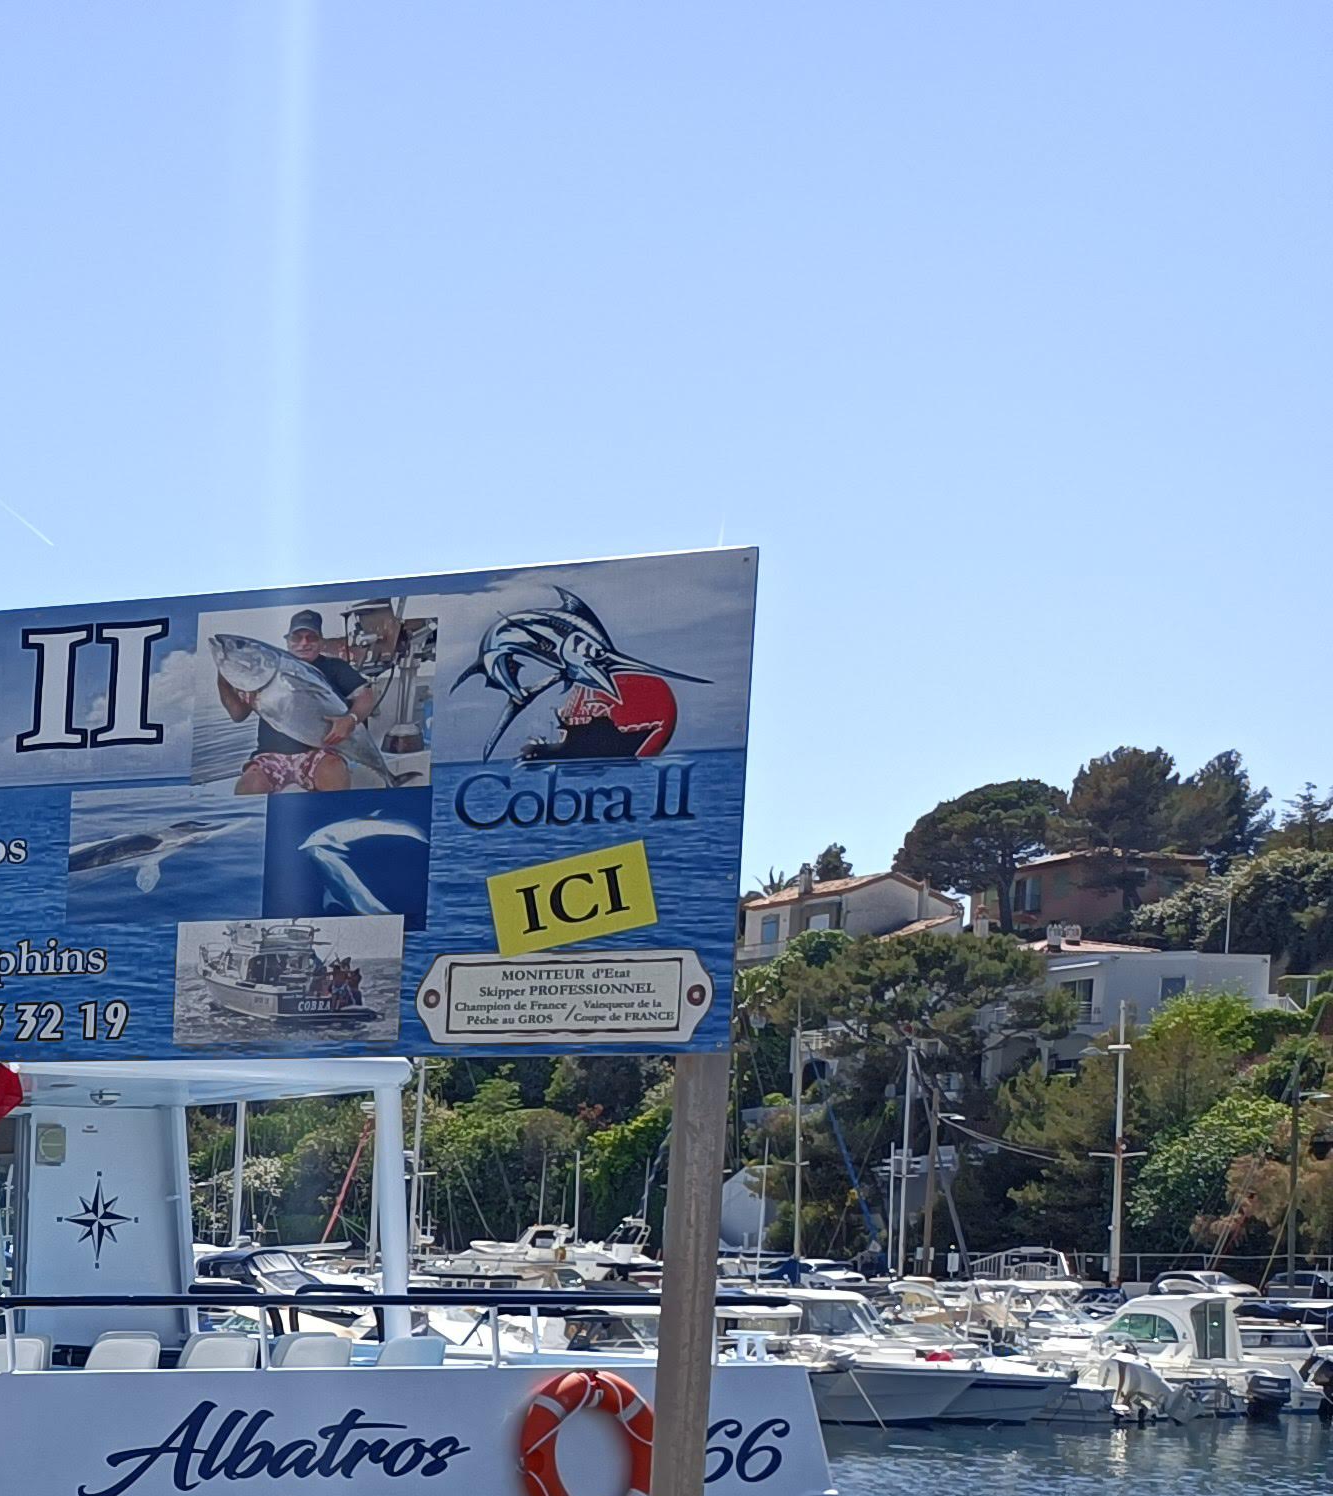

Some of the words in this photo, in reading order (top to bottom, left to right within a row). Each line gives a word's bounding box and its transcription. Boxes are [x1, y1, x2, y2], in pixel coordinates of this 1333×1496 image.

[16, 618, 169, 754] II
[453, 765, 631, 830] Cobra
[649, 759, 696, 822] II
[515, 862, 630, 935] ICI
[501, 969, 585, 981] MONITEUR
[592, 968, 630, 979] d'Etat
[480, 986, 525, 999] Skipper
[529, 983, 656, 996] PROFESSIONNEL
[297, 1001, 331, 1012] COBRA
[454, 1001, 512, 1015] Champion
[514, 1001, 527, 1011] de
[530, 1001, 568, 1011] France
[637, 999, 651, 1008] de
[15, 1002, 63, 1040] 32
[80, 1000, 129, 1039] 19
[466, 1014, 499, 1025] Pêche
[502, 1016, 515, 1024] au
[518, 1014, 553, 1024] GROS
[574, 1012, 605, 1023] Coupe
[609, 1012, 622, 1021] de
[624, 1011, 675, 1021] FRANCE
